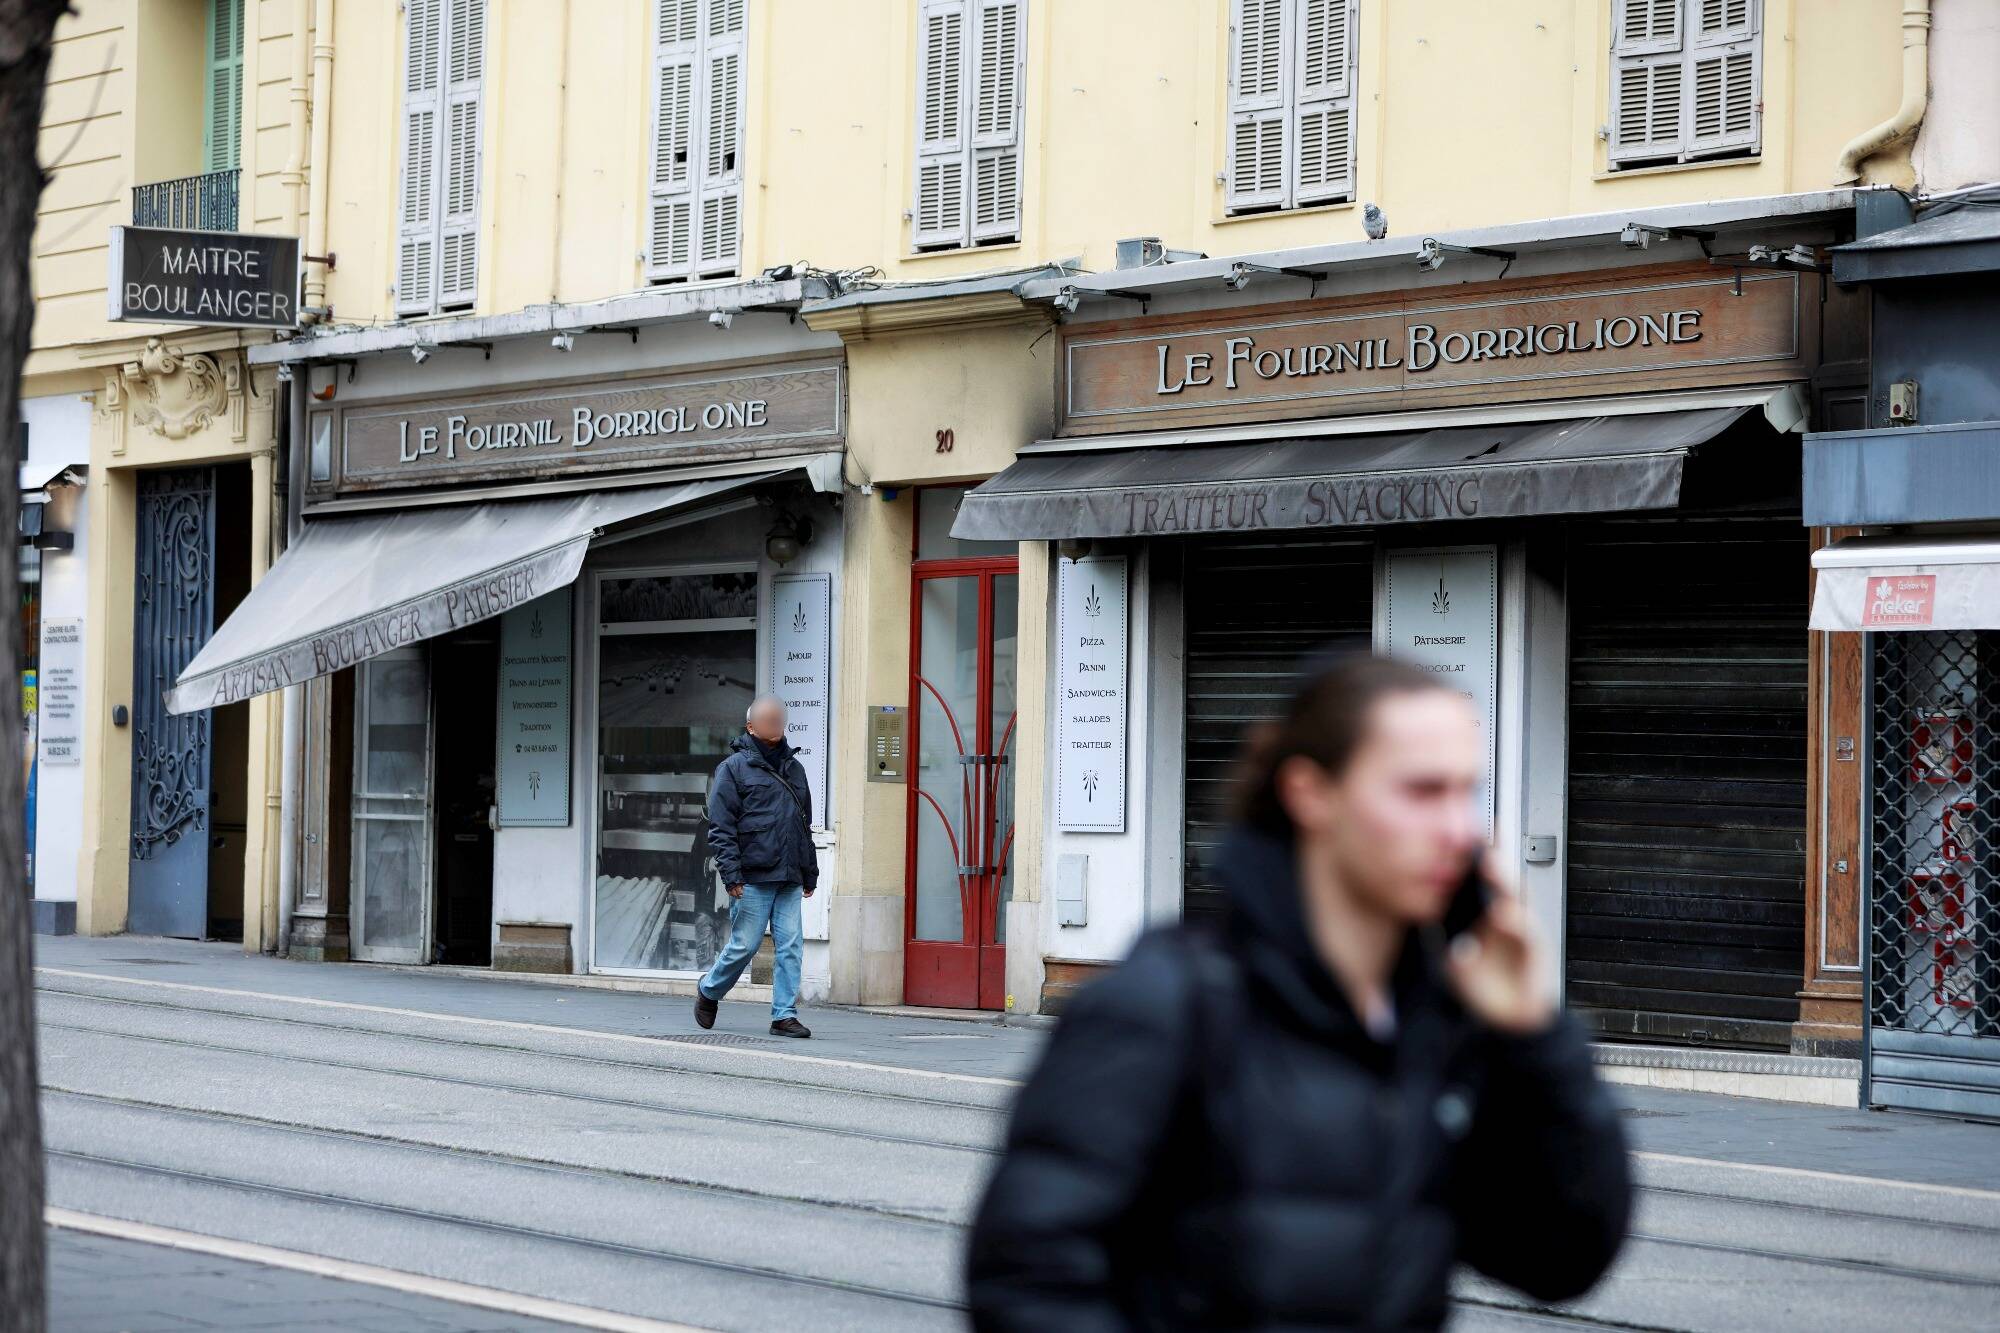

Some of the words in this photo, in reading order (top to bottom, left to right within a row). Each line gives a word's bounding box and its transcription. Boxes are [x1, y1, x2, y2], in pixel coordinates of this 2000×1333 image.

[162, 246, 260, 278] MAITRE
[125, 283, 290, 321] BOULANGER
[1157, 345, 1211, 395] LE
[1224, 336, 1404, 389] FOURNIL
[1405, 309, 1702, 373] BORRIGLIONE
[400, 420, 439, 463] LE
[446, 415, 562, 459] FOURNIL
[936, 429, 954, 453] 20
[1122, 489, 1269, 535] TRAITEUR
[1305, 477, 1480, 526] SNACKING
[211, 653, 293, 705] ARTISAN
[312, 608, 423, 675] BOULANGER
[444, 568, 535, 627] PATISSIER
[1080, 637, 1105, 647] PIZZA
[787, 652, 812, 661] AMOUR
[1079, 662, 1106, 674] PANINI
[784, 675, 814, 686] PASSION
[1067, 688, 1117, 699] SANDWICHS
[802, 700, 822, 708] FAIRE
[1072, 715, 1111, 723] SALADES
[1072, 741, 1112, 749] TRAITEUR
